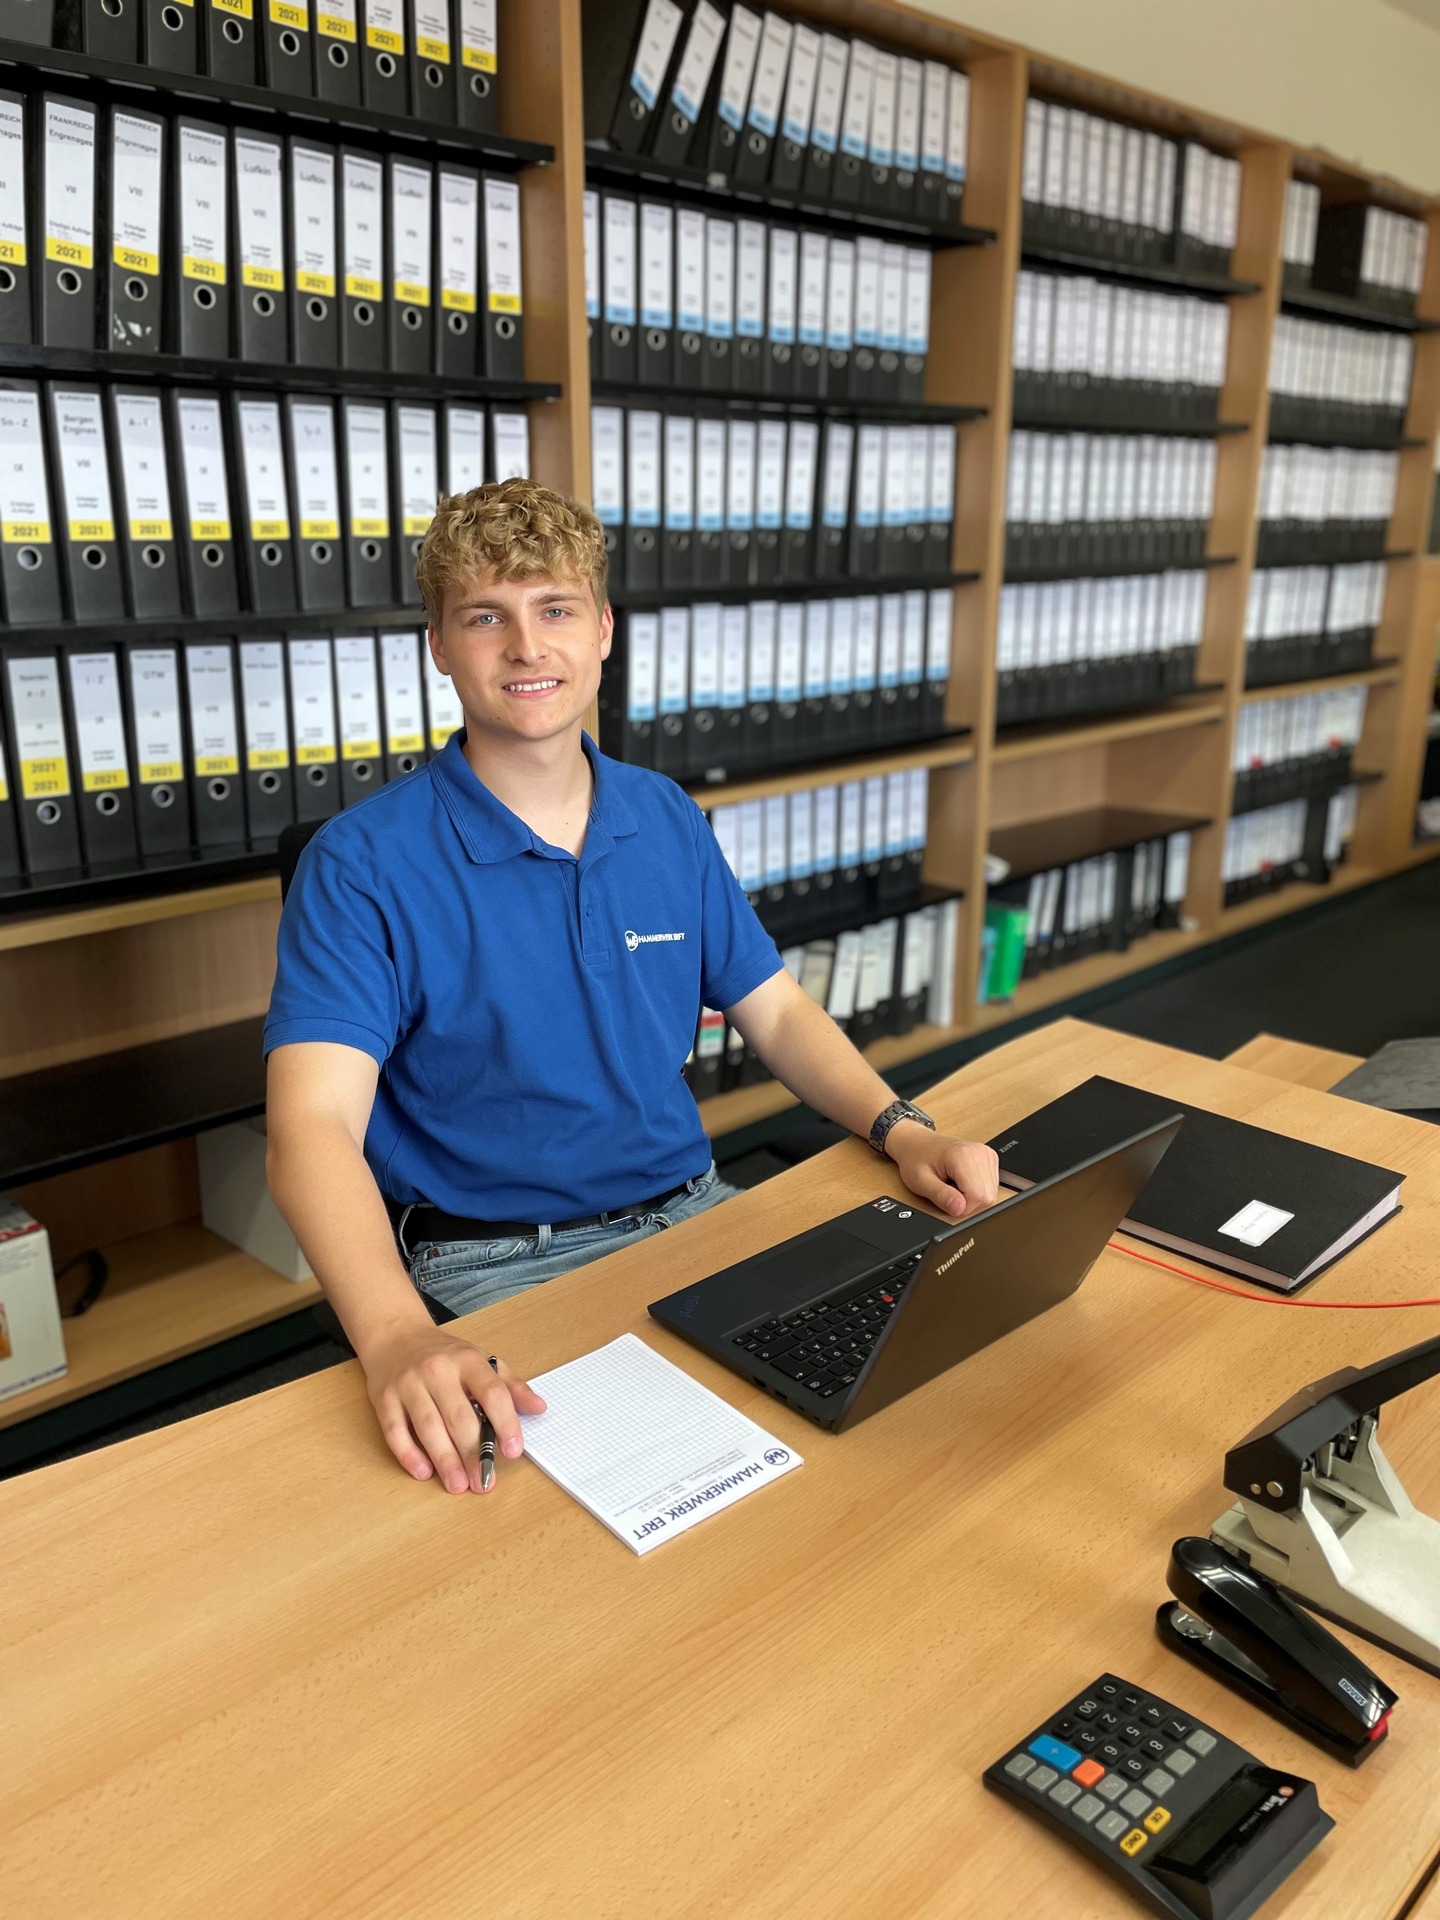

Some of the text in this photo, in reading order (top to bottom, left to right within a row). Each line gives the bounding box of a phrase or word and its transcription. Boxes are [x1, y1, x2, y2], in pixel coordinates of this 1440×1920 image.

[278, 7, 300, 22] 2021
[326, 20, 348, 34] 2021
[374, 32, 395, 47] 2021
[49, 114, 93, 131] FRANKREICH
[116, 116, 158, 133] FRANKREICH
[49, 129, 93, 147] Engrenages
[115, 136, 158, 153] Engrenages
[188, 152, 217, 167] Lufkin
[244, 163, 272, 176] Lufkin
[301, 172, 326, 185] Lufkin
[129, 185, 143, 196] VIII
[56, 244, 82, 260] 2021
[123, 252, 148, 267] 2021
[192, 263, 216, 276] 2021
[251, 271, 274, 284] 2021
[305, 277, 327, 289] 2021
[63, 425, 97, 436] Engines
[12, 526, 39, 537] 2021
[79, 524, 104, 535] 2021
[139, 524, 162, 535] 2021
[200, 525, 221, 535] 2021
[32, 762, 56, 773] 2021
[33, 780, 58, 791] 2021
[94, 774, 117, 785] 2021
[638, 933, 674, 944] HAMMERWERK
[935, 1238, 975, 1276] ThinkPad
[664, 1463, 764, 1521] HAMMERWERK
[633, 1516, 667, 1541] ERFT
[1103, 1685, 1116, 1693] 0
[1340, 1680, 1366, 1705] novus
[1125, 1696, 1137, 1704] 1
[1078, 1700, 1097, 1714] 00
[1147, 1708, 1160, 1717] 4
[1102, 1713, 1117, 1723] 2
[1126, 1726, 1140, 1736] 5
[1172, 1721, 1186, 1732] 7
[1081, 1732, 1095, 1742] 3
[1104, 1745, 1118, 1756] 6
[1149, 1740, 1163, 1751] 8
[1128, 1760, 1142, 1770] 9
[1151, 1811, 1164, 1825] CE
